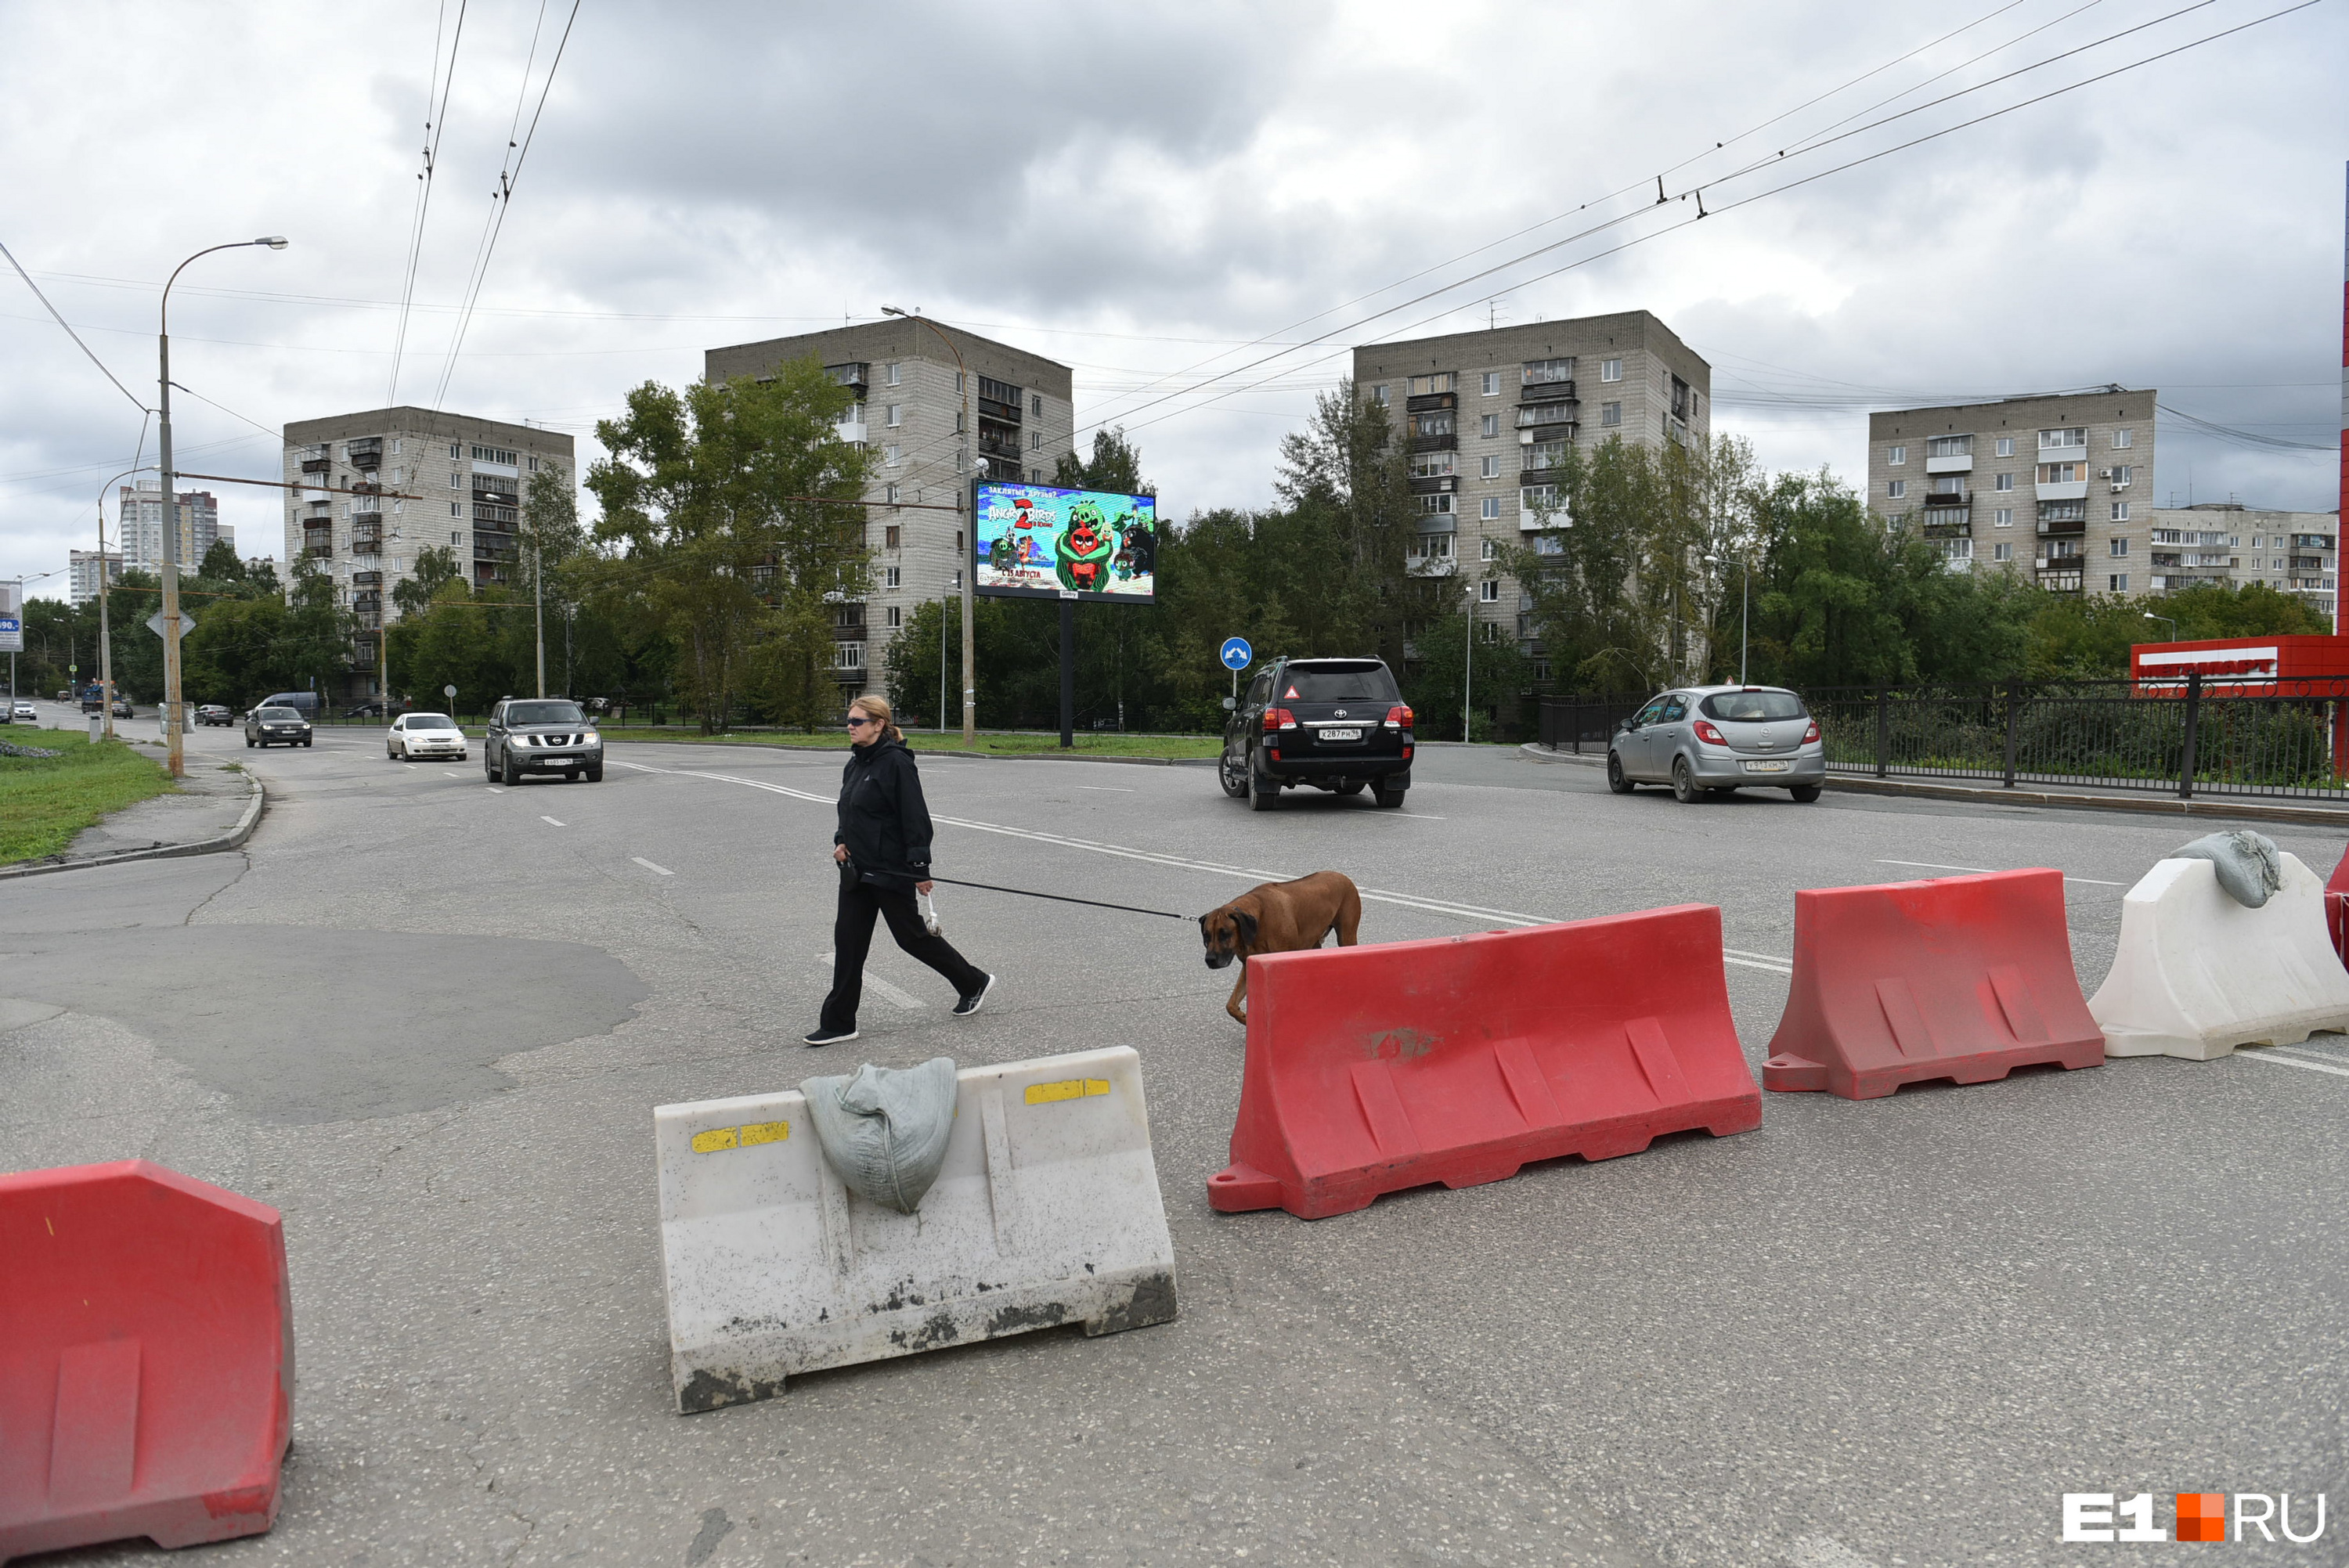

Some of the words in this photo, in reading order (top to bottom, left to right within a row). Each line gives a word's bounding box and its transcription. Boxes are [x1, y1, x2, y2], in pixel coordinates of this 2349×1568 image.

[988, 486, 1027, 496] ЗАКЛЯТЫЕ
[988, 505, 1022, 522] ANGRY
[1012, 499, 1034, 530] 2
[1026, 507, 1057, 523] BIRDS
[1015, 570, 1041, 579] АВГУСТА
